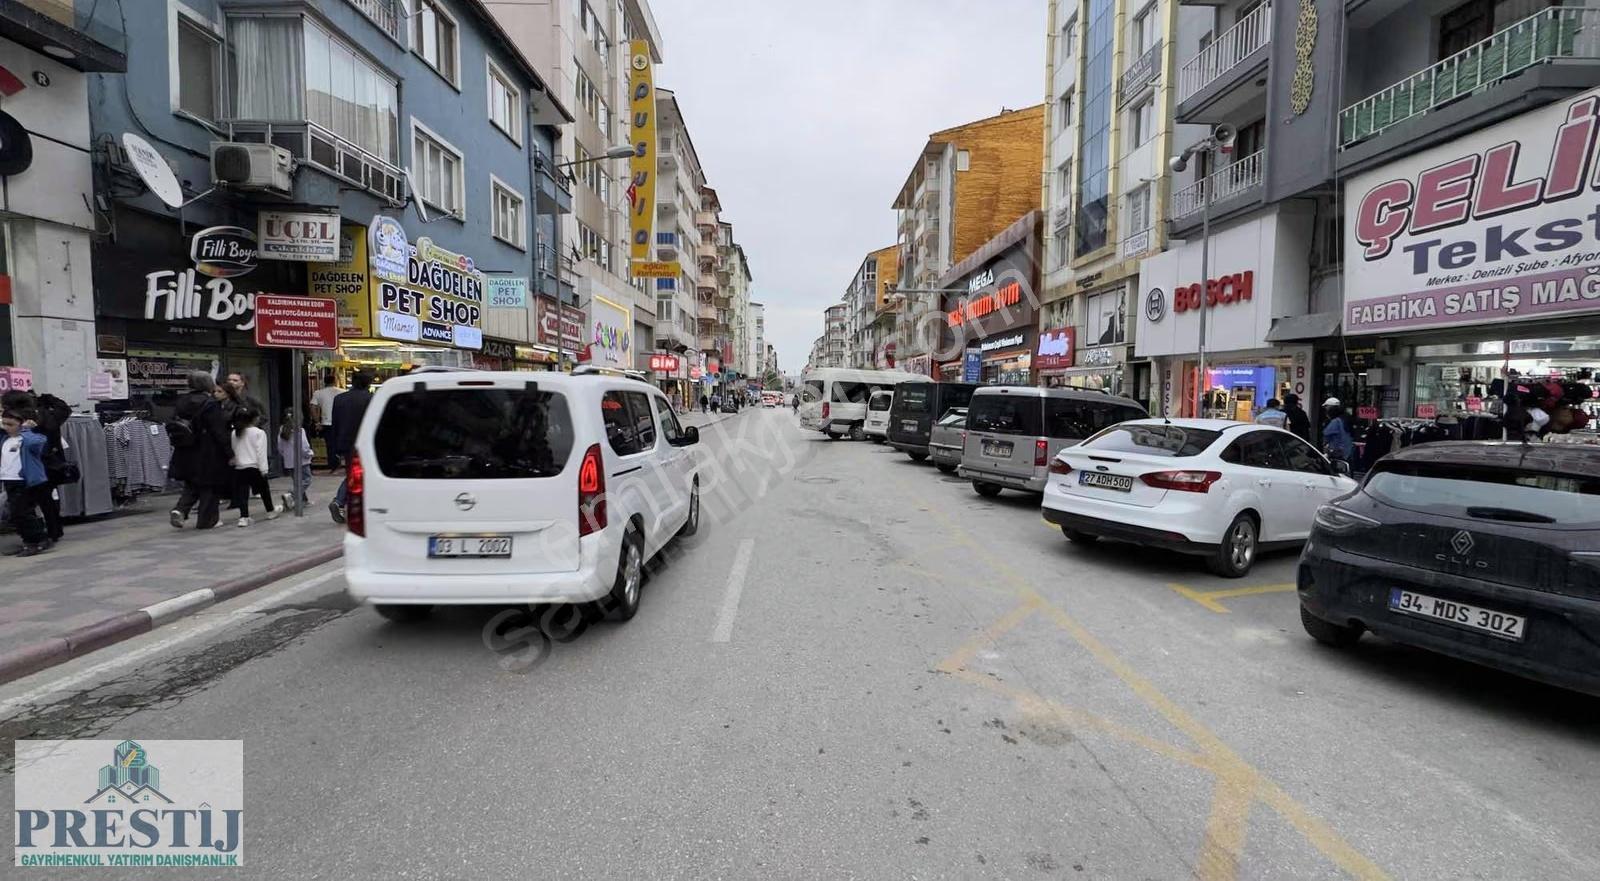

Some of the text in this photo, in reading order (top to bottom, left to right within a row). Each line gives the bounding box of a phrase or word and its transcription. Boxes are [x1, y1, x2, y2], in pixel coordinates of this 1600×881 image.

[1355, 95, 1600, 262] ÇELİ
[202, 240, 227, 257] Filli
[228, 241, 258, 263] Boya
[311, 271, 364, 283] DAĞDELEN
[408, 257, 482, 302] DAĞDELEN
[968, 268, 994, 294] MEGA
[1426, 274, 1463, 287] Merkez
[1472, 264, 1513, 280] Denizli
[1514, 259, 1549, 275] Şube
[144, 268, 258, 331] Filli Boy
[314, 283, 362, 294] PET SHOP
[497, 287, 517, 296] PET
[1174, 271, 1254, 313] BOSCH
[381, 283, 480, 326] PET SHOP
[492, 297, 521, 306] SHOP
[1351, 295, 1437, 324] FABRİKA
[1445, 286, 1521, 314] SATIŞ
[423, 326, 452, 340] ADVANCE
[652, 355, 675, 369] BİM
[1084, 472, 1095, 484] 27
[1113, 476, 1130, 488] 500
[437, 539, 509, 553] 03 L 2002
[1435, 553, 1488, 568] CLIO
[1401, 592, 1423, 611] 34
[1432, 600, 1470, 622] MDS
[1477, 610, 1519, 635] 302
